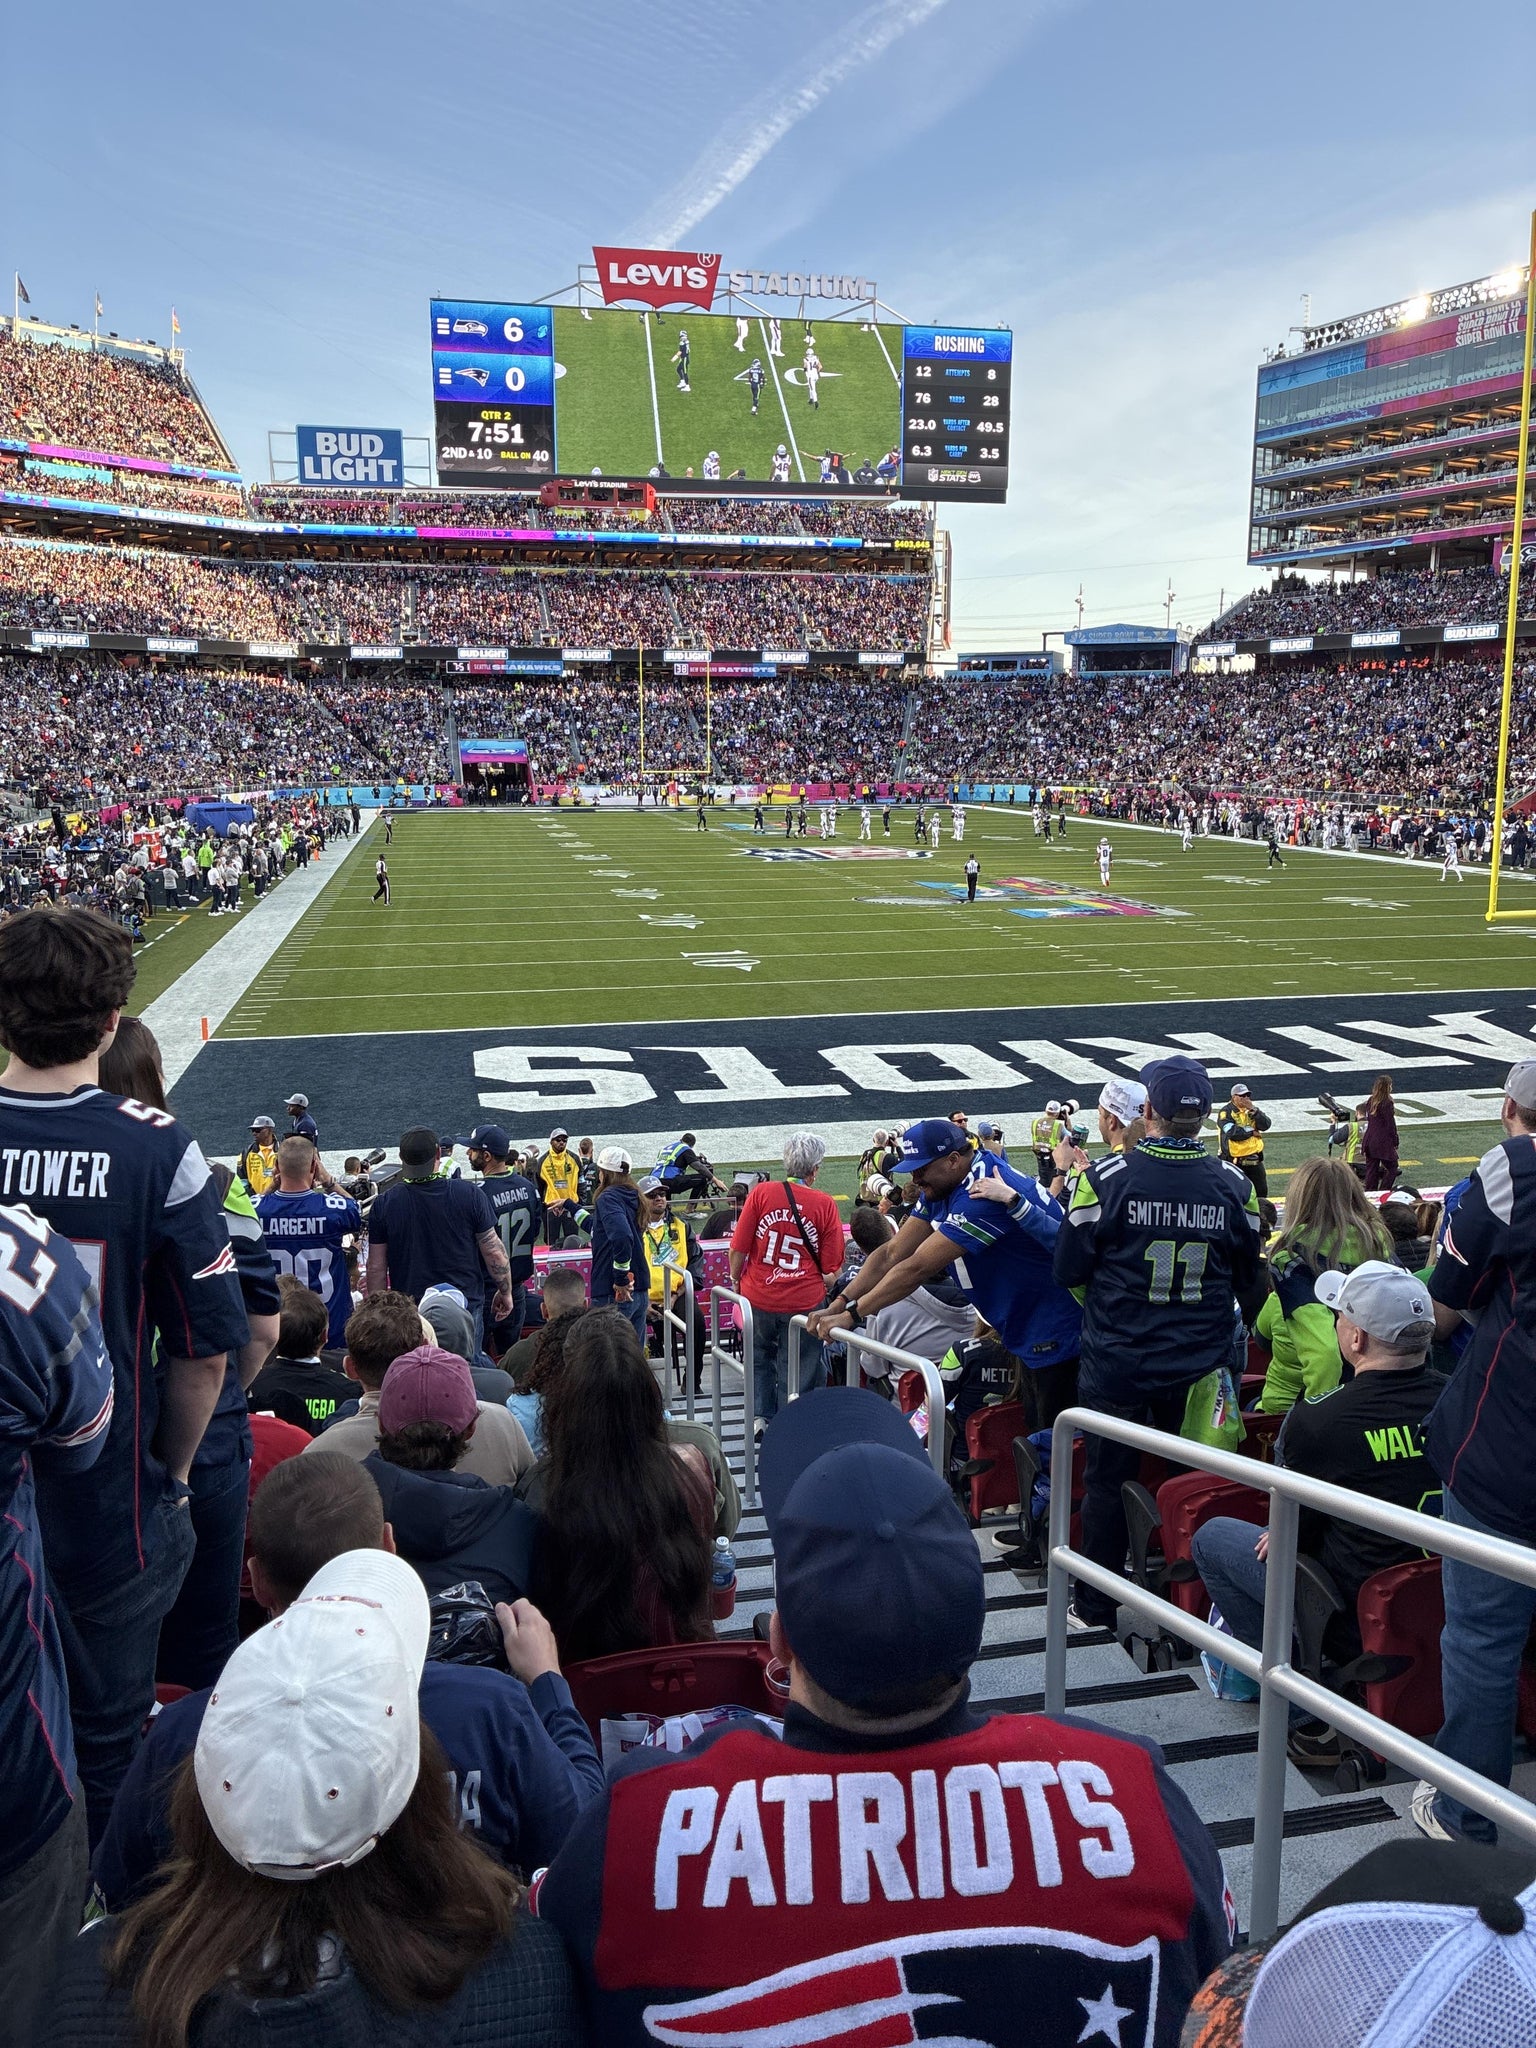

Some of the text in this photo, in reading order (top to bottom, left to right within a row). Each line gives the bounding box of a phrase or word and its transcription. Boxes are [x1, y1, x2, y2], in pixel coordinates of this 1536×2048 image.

[729, 269, 868, 300] STADIUM
[503, 317, 524, 342] 6
[934, 335, 985, 354] RUSHING
[505, 366, 526, 392] 0
[916, 366, 932, 378] 12
[987, 369, 996, 380] 8
[915, 392, 932, 404] 76
[982, 396, 1000, 406] 28
[480, 410, 512, 420] QTR 2
[908, 418, 936, 430] 23.0
[976, 422, 1004, 433] 49.5
[468, 422, 524, 444] 7:51
[316, 432, 384, 458] BUD
[442, 446, 467, 459] 2ND
[477, 448, 492, 460] 10
[500, 451, 519, 459] BALL
[532, 450, 550, 462] 40
[912, 446, 932, 456] 6.3
[980, 448, 1000, 459] 3.5
[35, 634, 88, 646] BUD LIGHT
[1353, 633, 1399, 646] BUD LIGHT
[1446, 626, 1498, 640] BUD LIGHT
[150, 640, 197, 650] BUD LIGHT
[252, 644, 295, 656] BUD LIGHT
[1198, 644, 1235, 655] BUD LIGHT
[1272, 638, 1312, 651] BUD LIGHT
[353, 649, 400, 658] BUD LIGHT
[460, 650, 506, 658] BUD LIGHT
[564, 651, 610, 660] BUD LIGHT
[666, 652, 710, 660] BUD LIGHT
[782, 654, 808, 662] LIGHT
[862, 654, 902, 662] BUD LIGHT
[610, 786, 639, 797] SUPER
[1102, 850, 1108, 858] 0
[473, 1004, 1536, 1112] ATRIOTS
[2, 1149, 111, 1198] TOWER
[492, 1187, 529, 1208] NARANG
[1128, 1200, 1225, 1230] SMITH-NJIGBA
[260, 1216, 327, 1236] LARGENT
[756, 1208, 790, 1240] PATRICK
[497, 1207, 532, 1259] 12
[762, 1230, 804, 1270] 15
[1144, 1240, 1209, 1304] 11
[654, 1760, 1136, 1911] PATRIOTS
